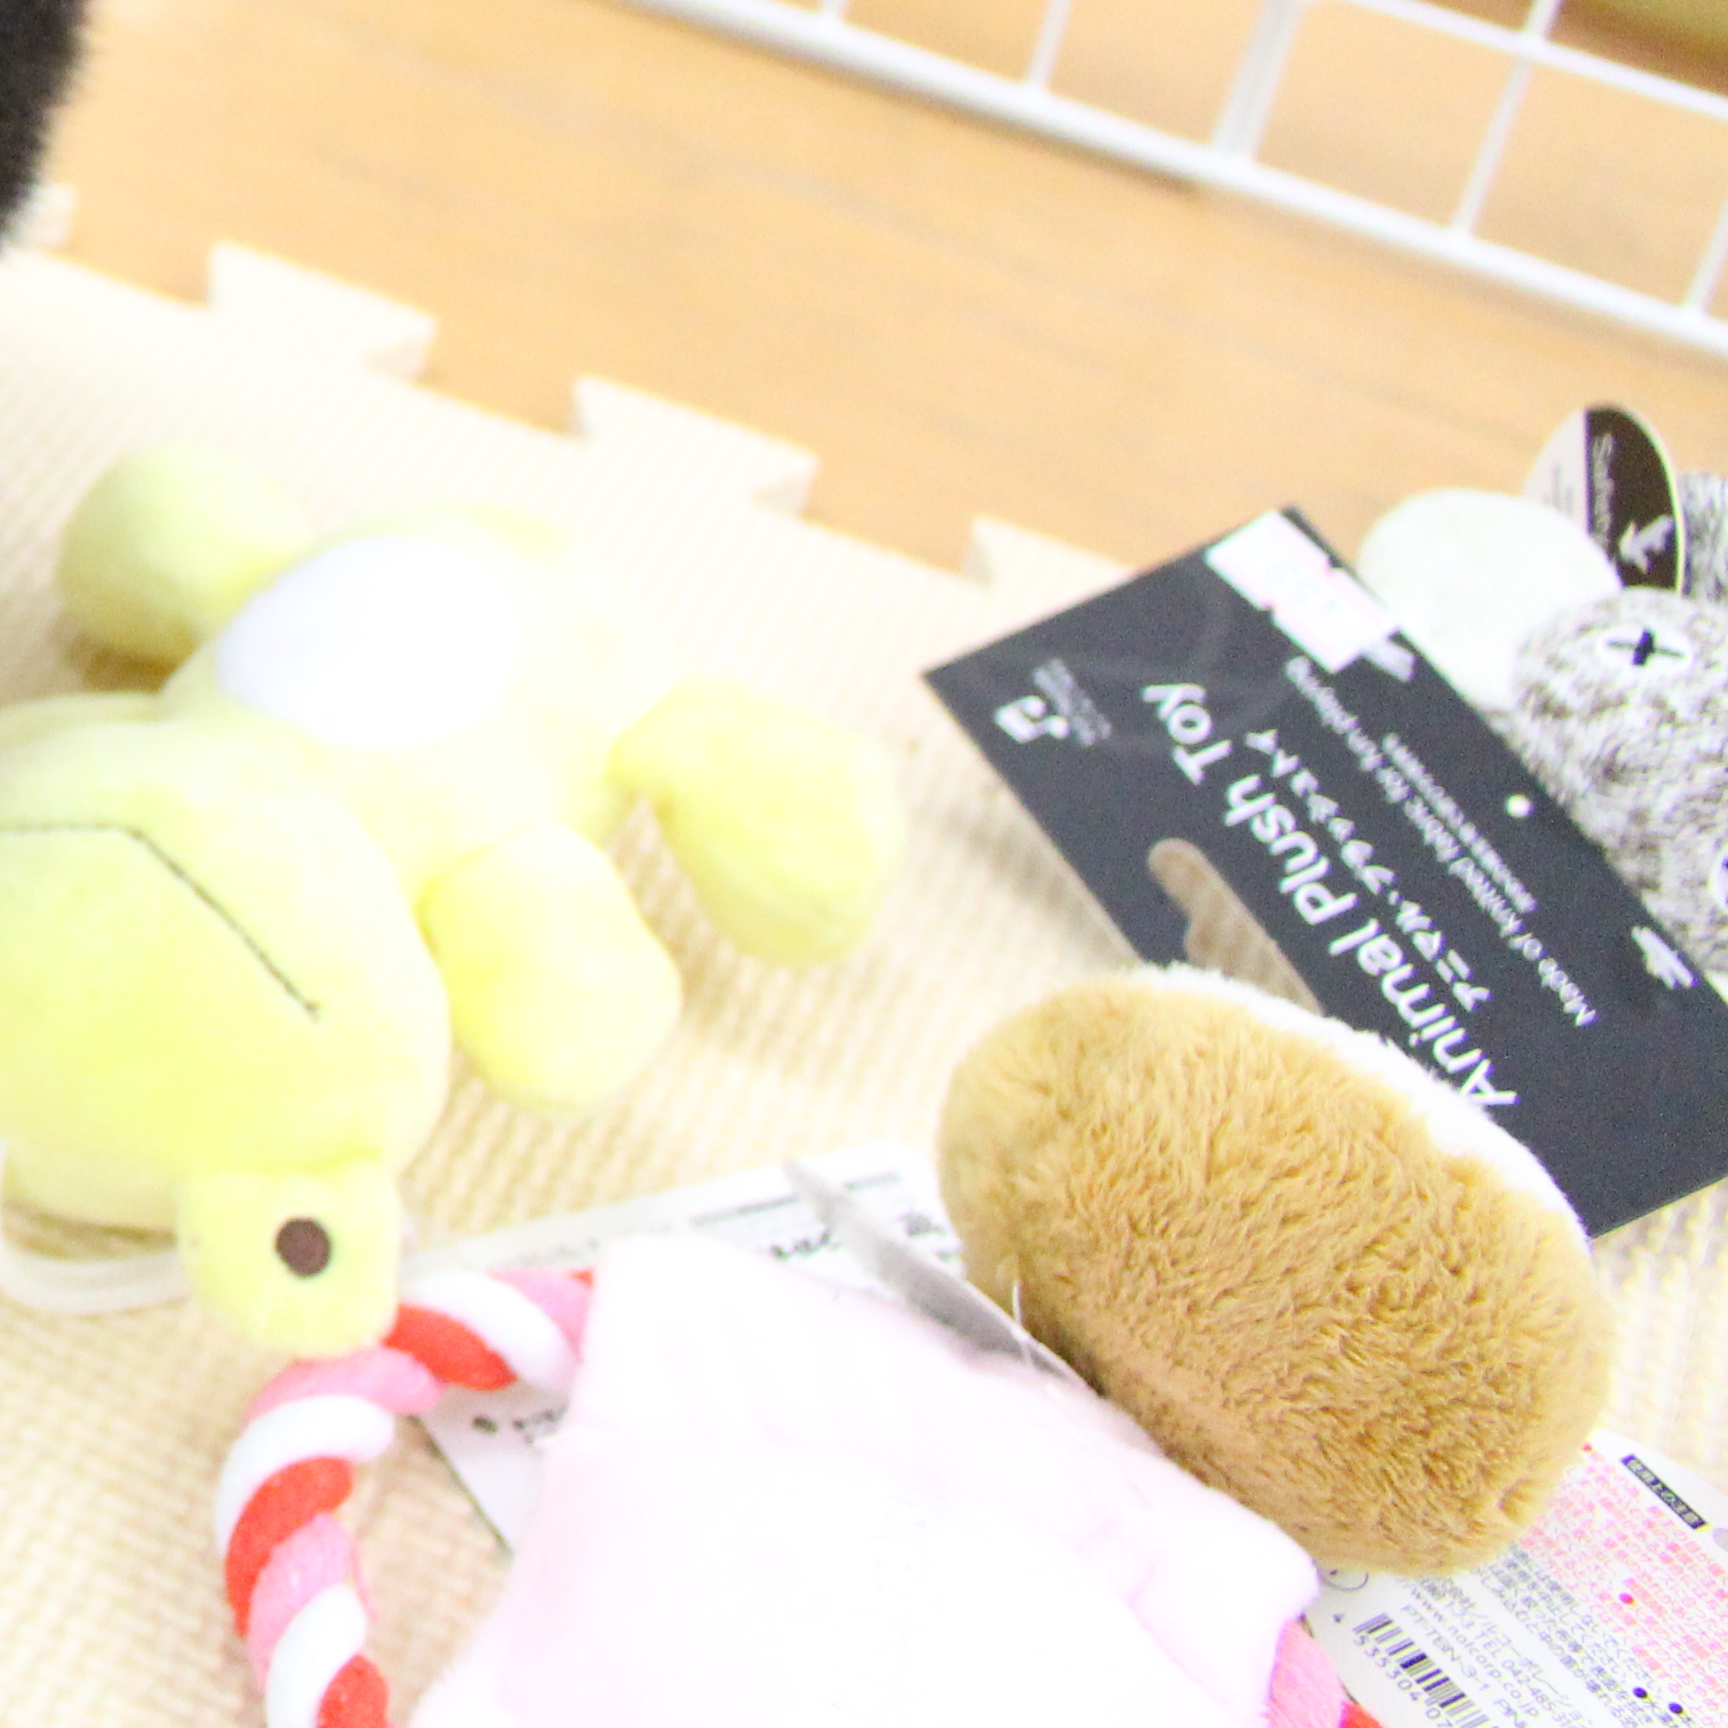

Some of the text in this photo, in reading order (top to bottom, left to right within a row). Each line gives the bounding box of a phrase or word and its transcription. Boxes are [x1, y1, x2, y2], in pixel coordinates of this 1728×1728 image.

[1138, 680, 1230, 783] Toy
[1220, 770, 1358, 927] Plush
[1326, 916, 1520, 1106] Animal
